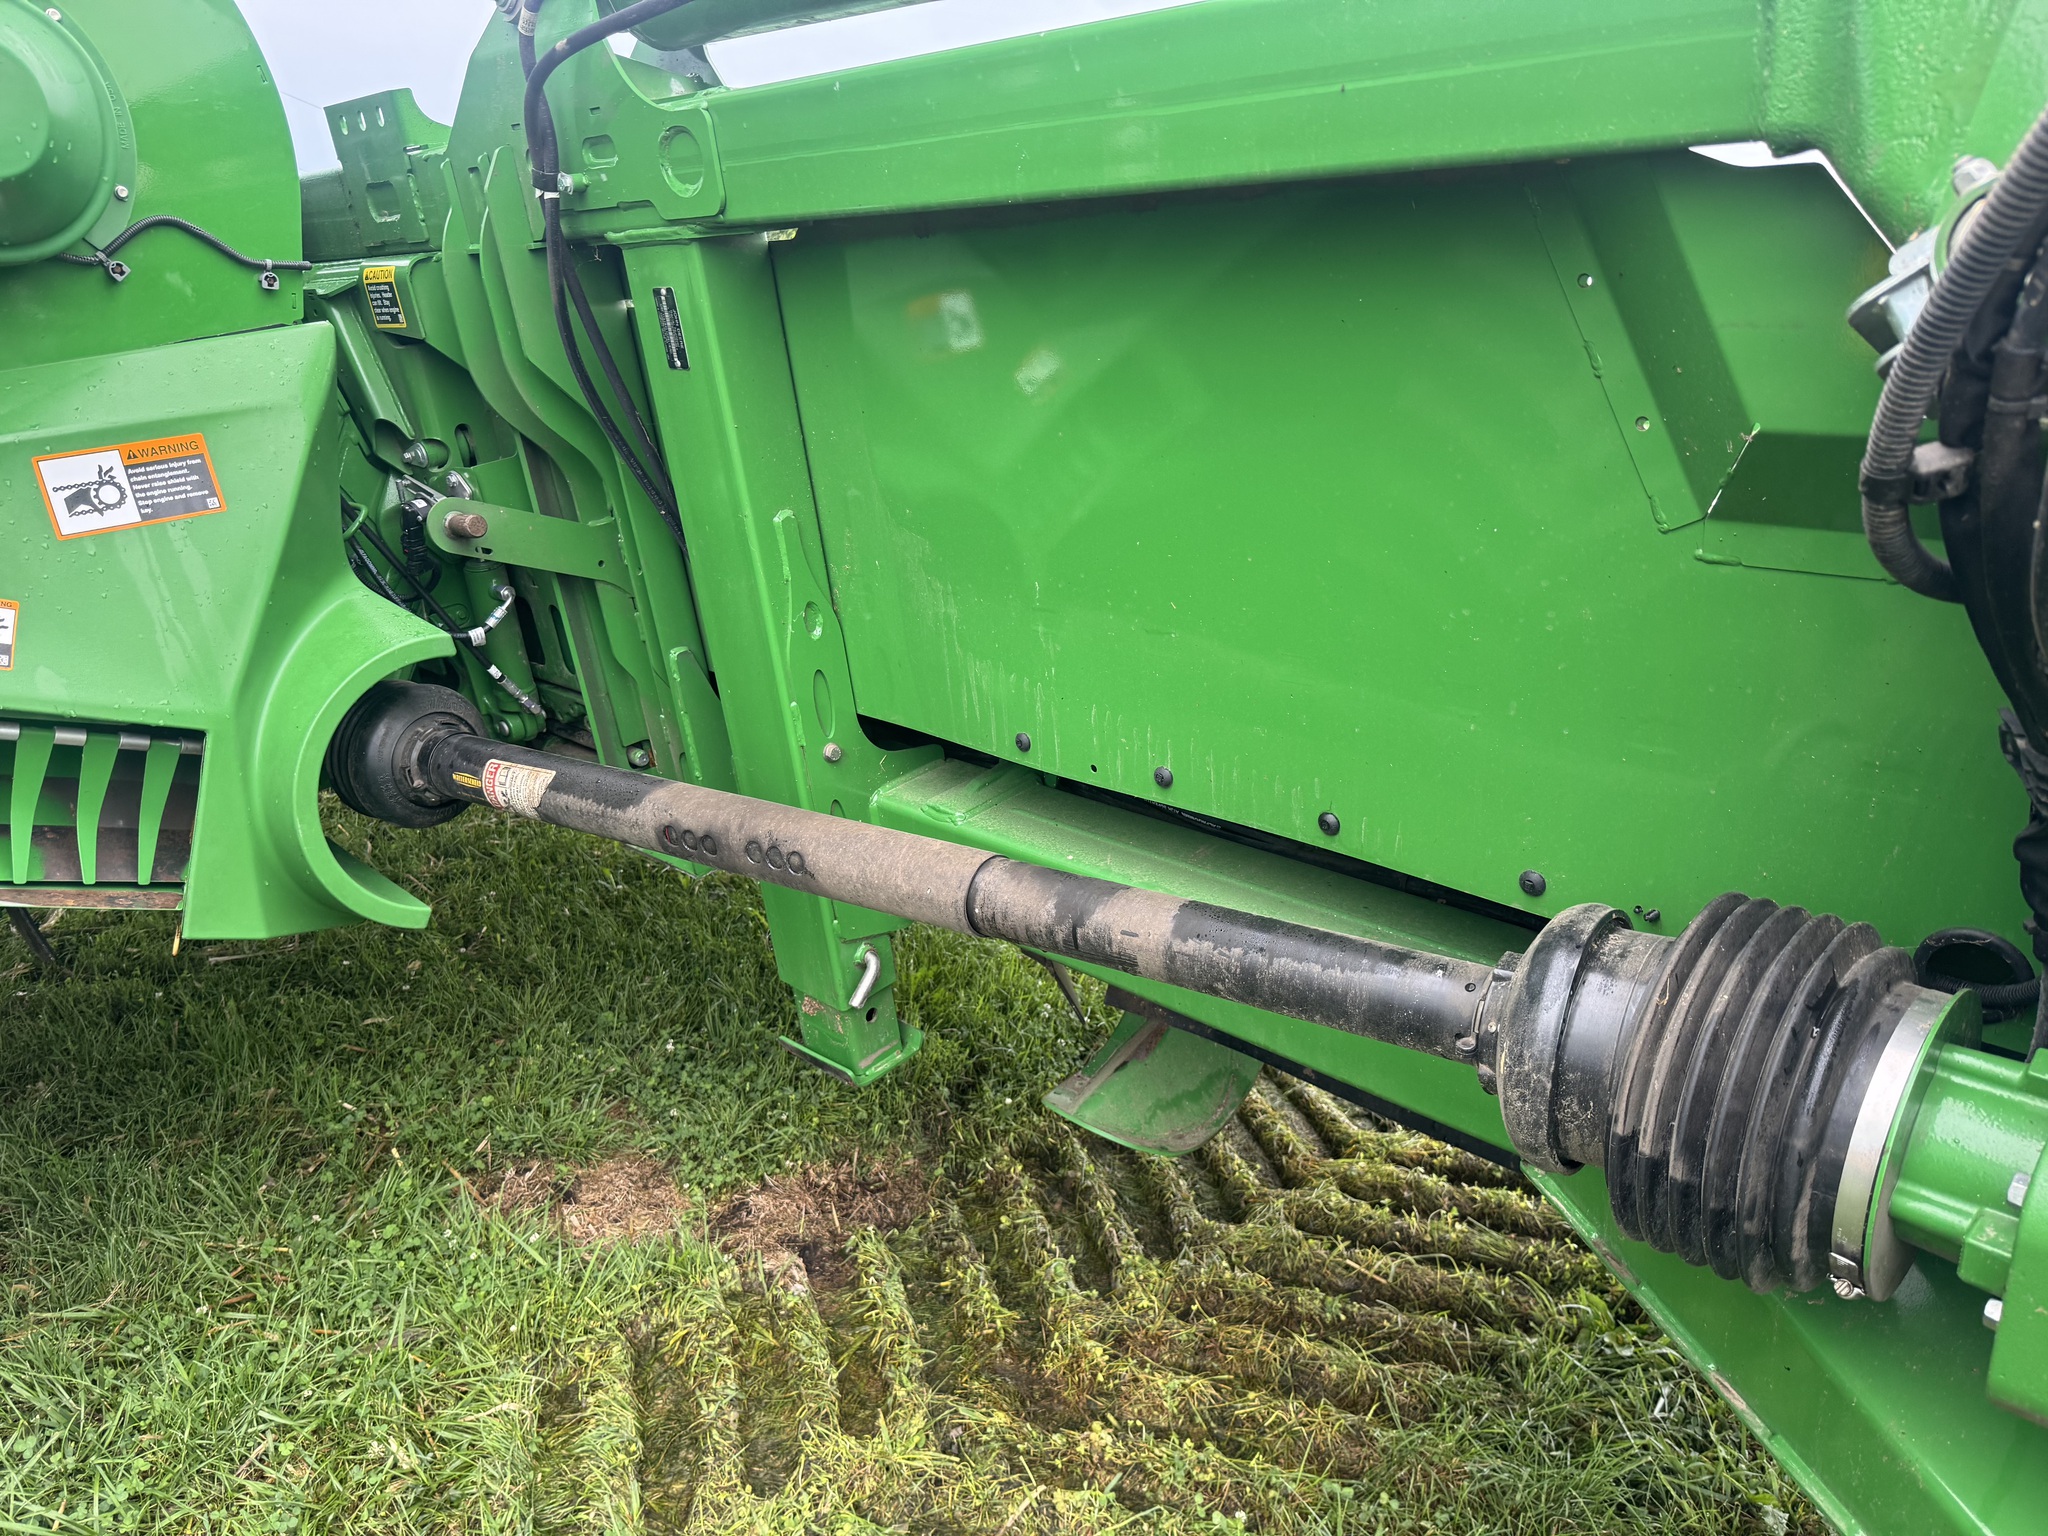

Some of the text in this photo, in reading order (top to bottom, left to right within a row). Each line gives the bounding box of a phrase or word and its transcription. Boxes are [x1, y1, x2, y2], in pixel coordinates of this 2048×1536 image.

[114, 106, 123, 116] IN
[118, 122, 130, 150] MADE
[368, 270, 392, 280] CAUTION
[138, 440, 199, 458] WARNING
[146, 464, 168, 472] serious
[148, 469, 190, 480] entanglement.
[146, 488, 167, 497] engine
[153, 496, 174, 504] engine
[484, 762, 503, 809] DANGER
